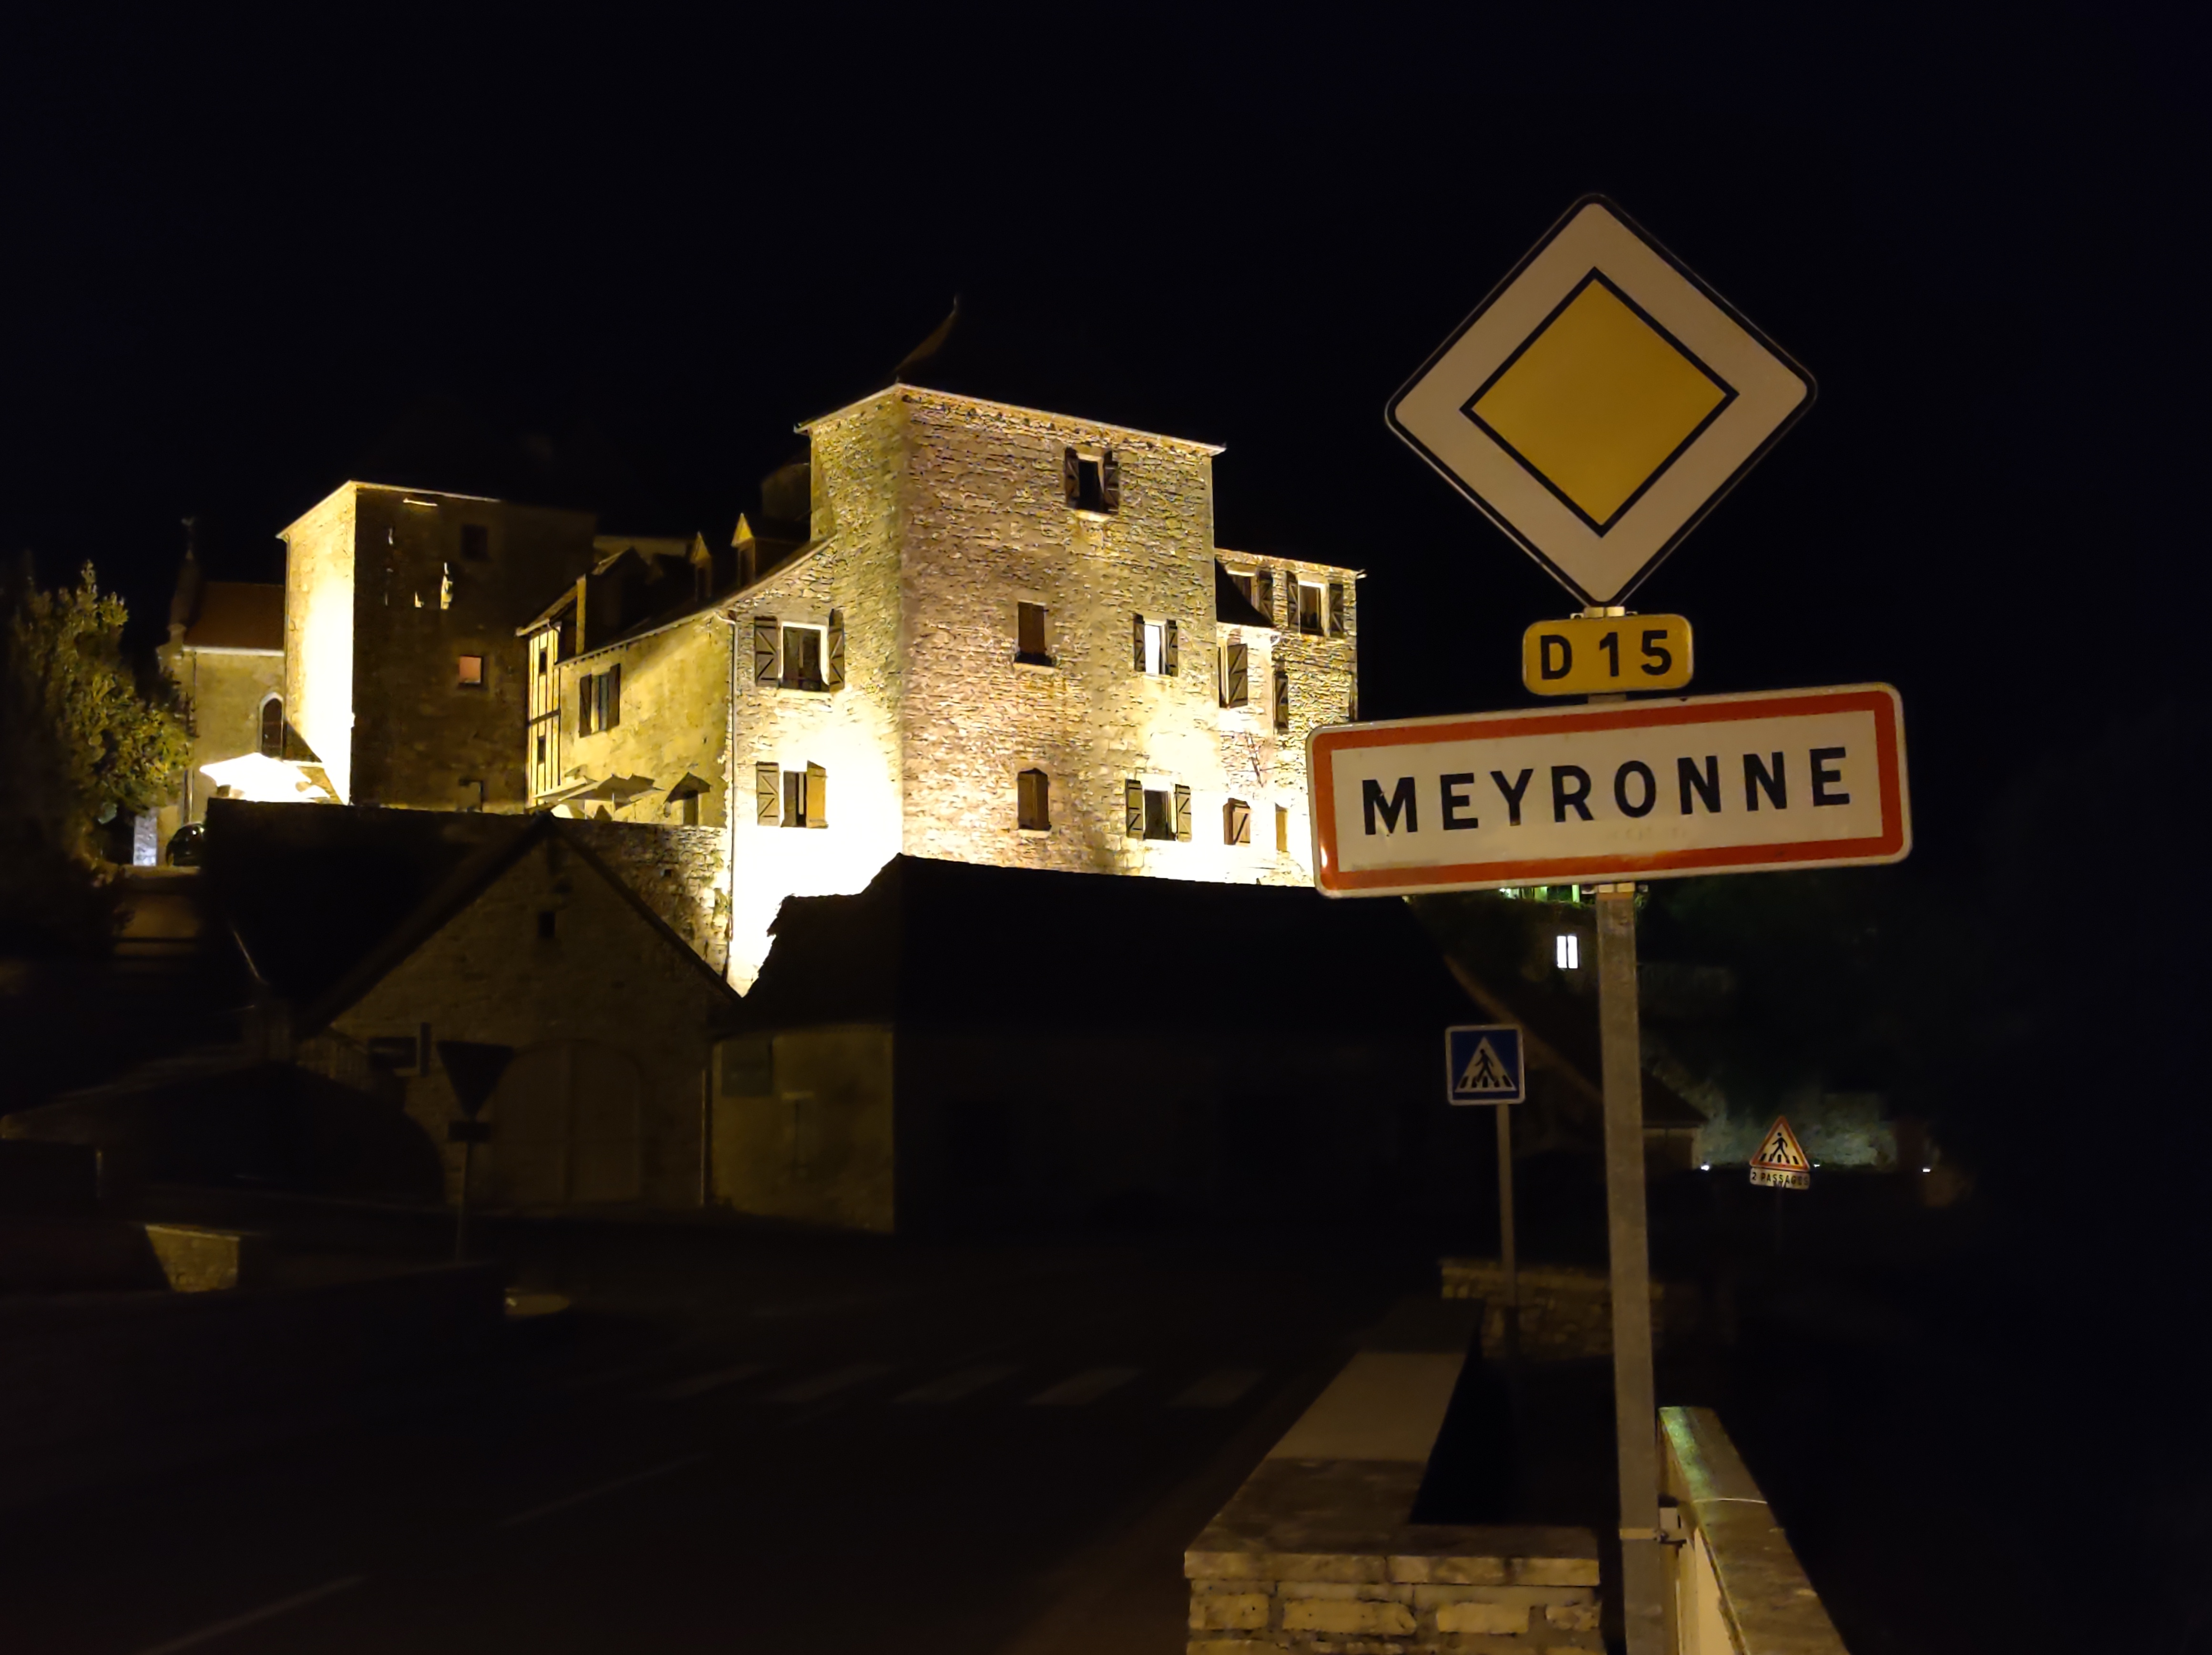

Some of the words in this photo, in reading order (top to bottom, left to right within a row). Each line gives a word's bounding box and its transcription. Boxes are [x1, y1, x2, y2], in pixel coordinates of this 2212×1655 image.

[1540, 634, 1572, 680] D
[1599, 630, 1672, 675] 15
[1362, 746, 1850, 836] MEYRONNE
[1752, 1172, 1756, 1181] 2
